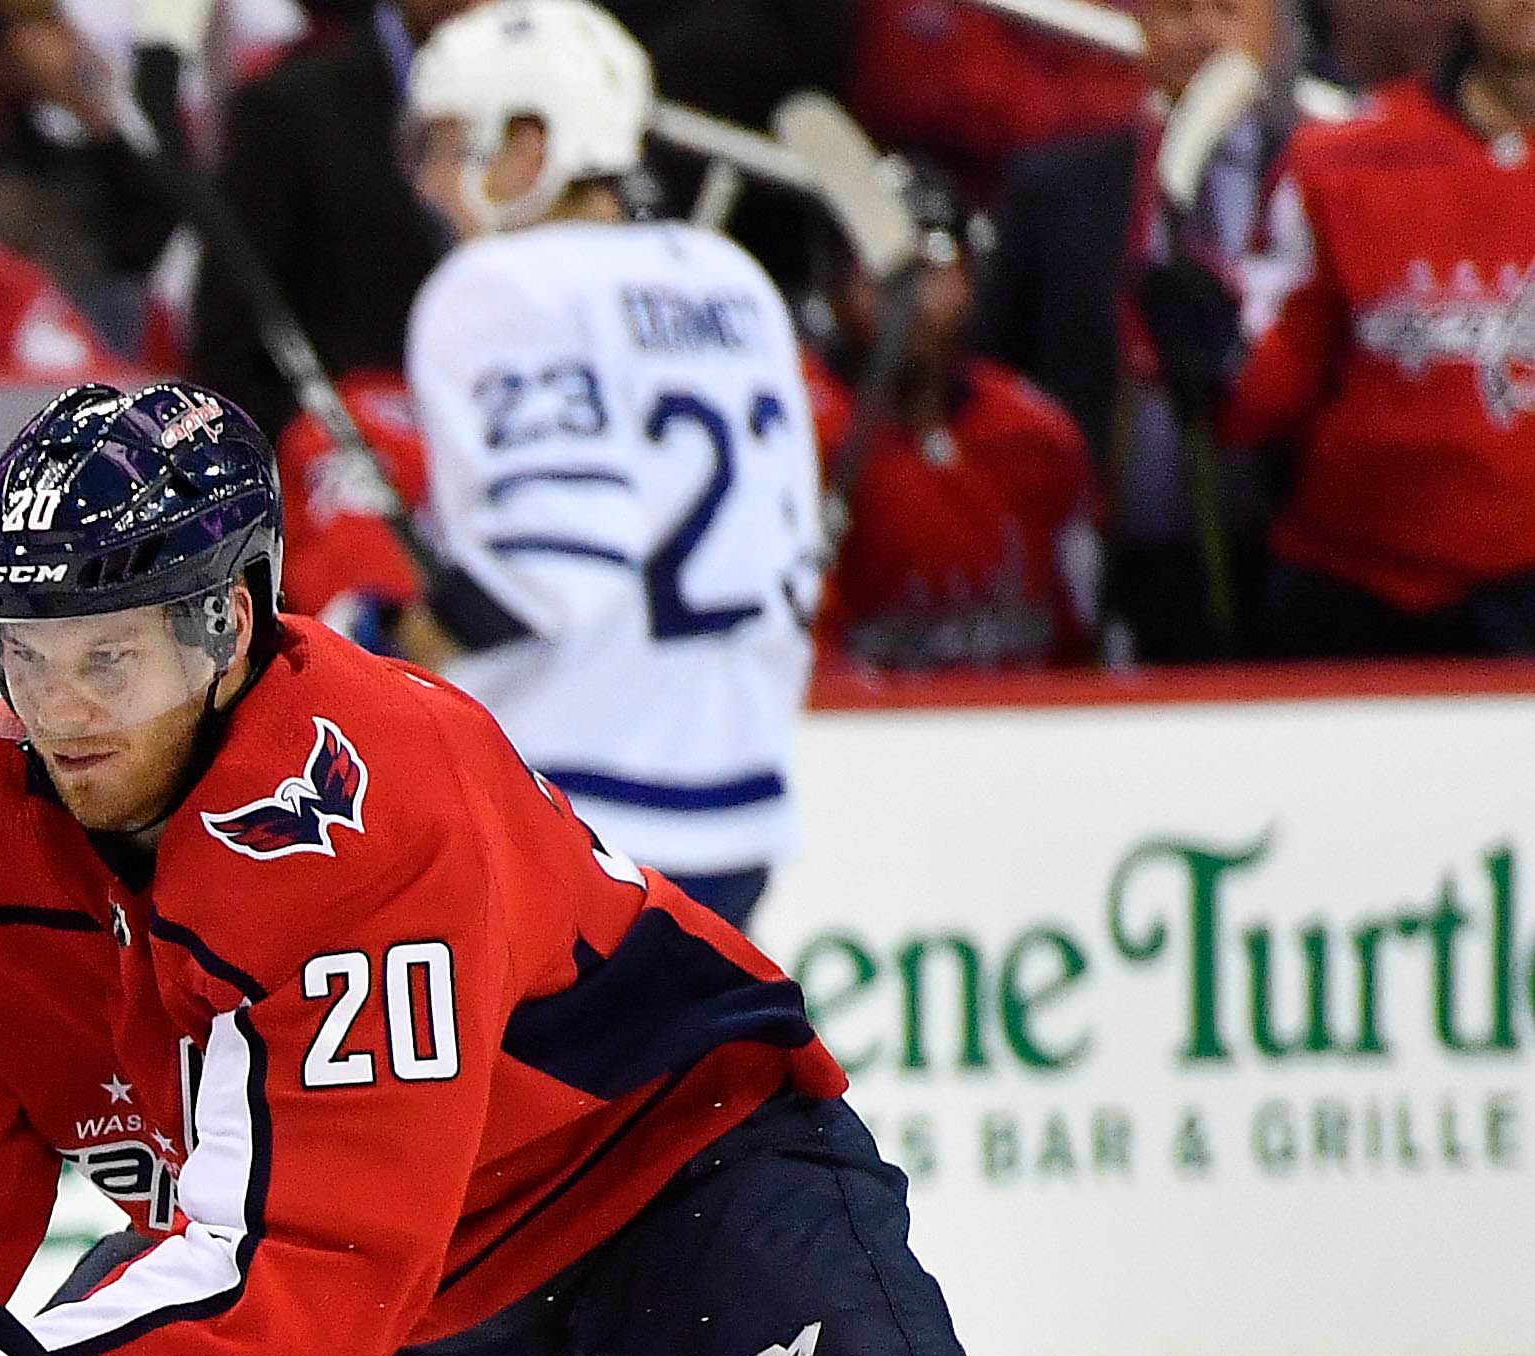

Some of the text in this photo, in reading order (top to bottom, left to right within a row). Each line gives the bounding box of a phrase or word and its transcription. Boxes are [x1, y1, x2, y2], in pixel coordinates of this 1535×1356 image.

[472, 364, 608, 447] 23
[2, 489, 61, 532] 20
[791, 814, 1535, 1073] ene Turtl
[302, 938, 461, 1089] 20
[75, 1114, 143, 1140] WAS
